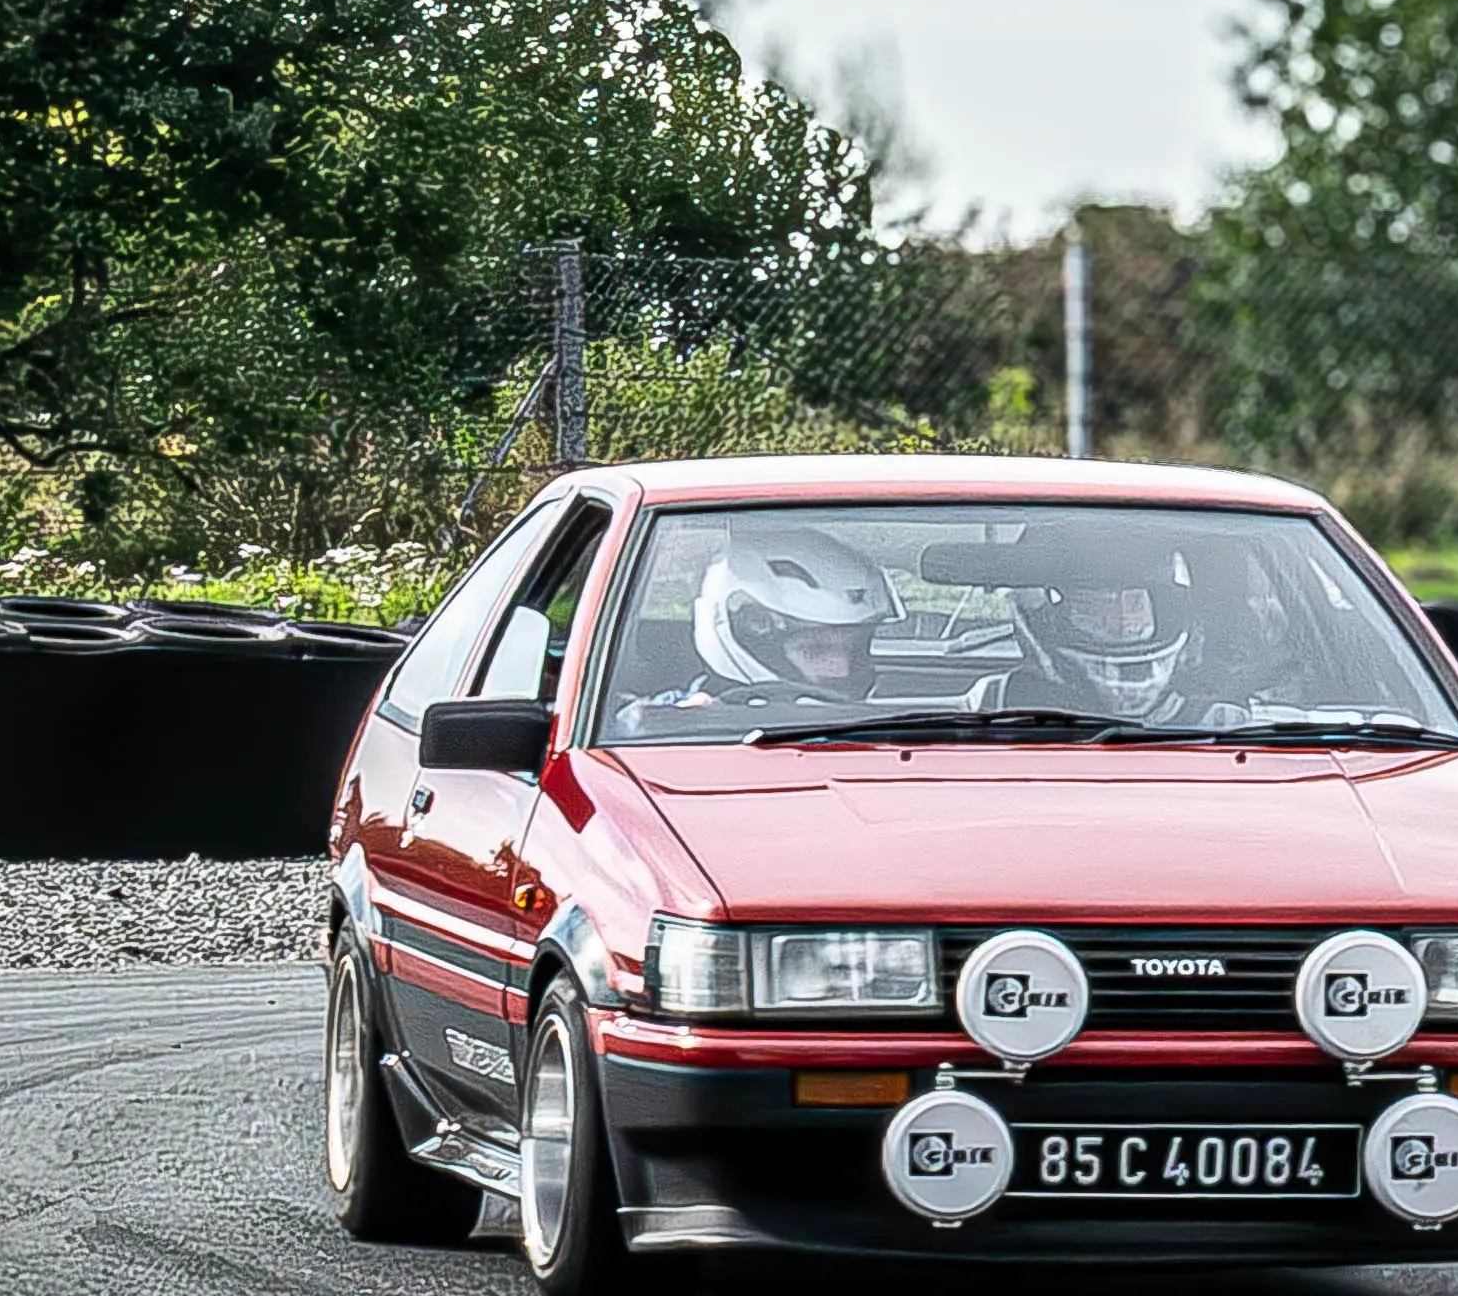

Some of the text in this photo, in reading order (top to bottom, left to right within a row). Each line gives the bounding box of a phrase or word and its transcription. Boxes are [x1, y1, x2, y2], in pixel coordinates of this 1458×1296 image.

[1130, 958, 1226, 976] TOYOTA
[1041, 1135, 1325, 1187] 85 C 40084
